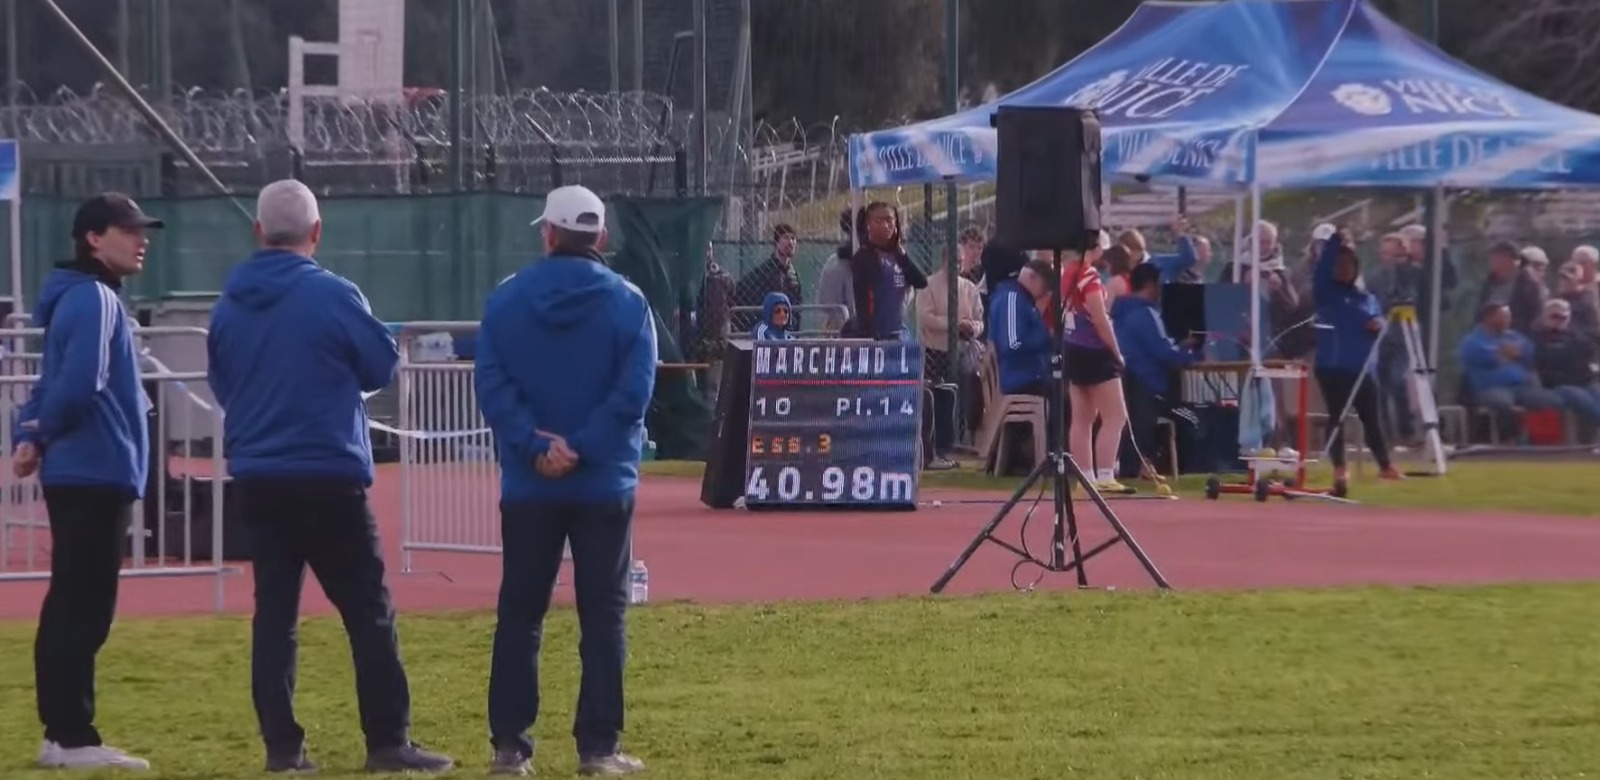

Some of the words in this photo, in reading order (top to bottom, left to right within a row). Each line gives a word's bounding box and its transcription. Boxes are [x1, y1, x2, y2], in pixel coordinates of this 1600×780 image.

[756, 346, 885, 374] MARCHAND
[901, 346, 909, 373] L
[756, 397, 791, 415] 10
[747, 466, 912, 500] 40.98m
